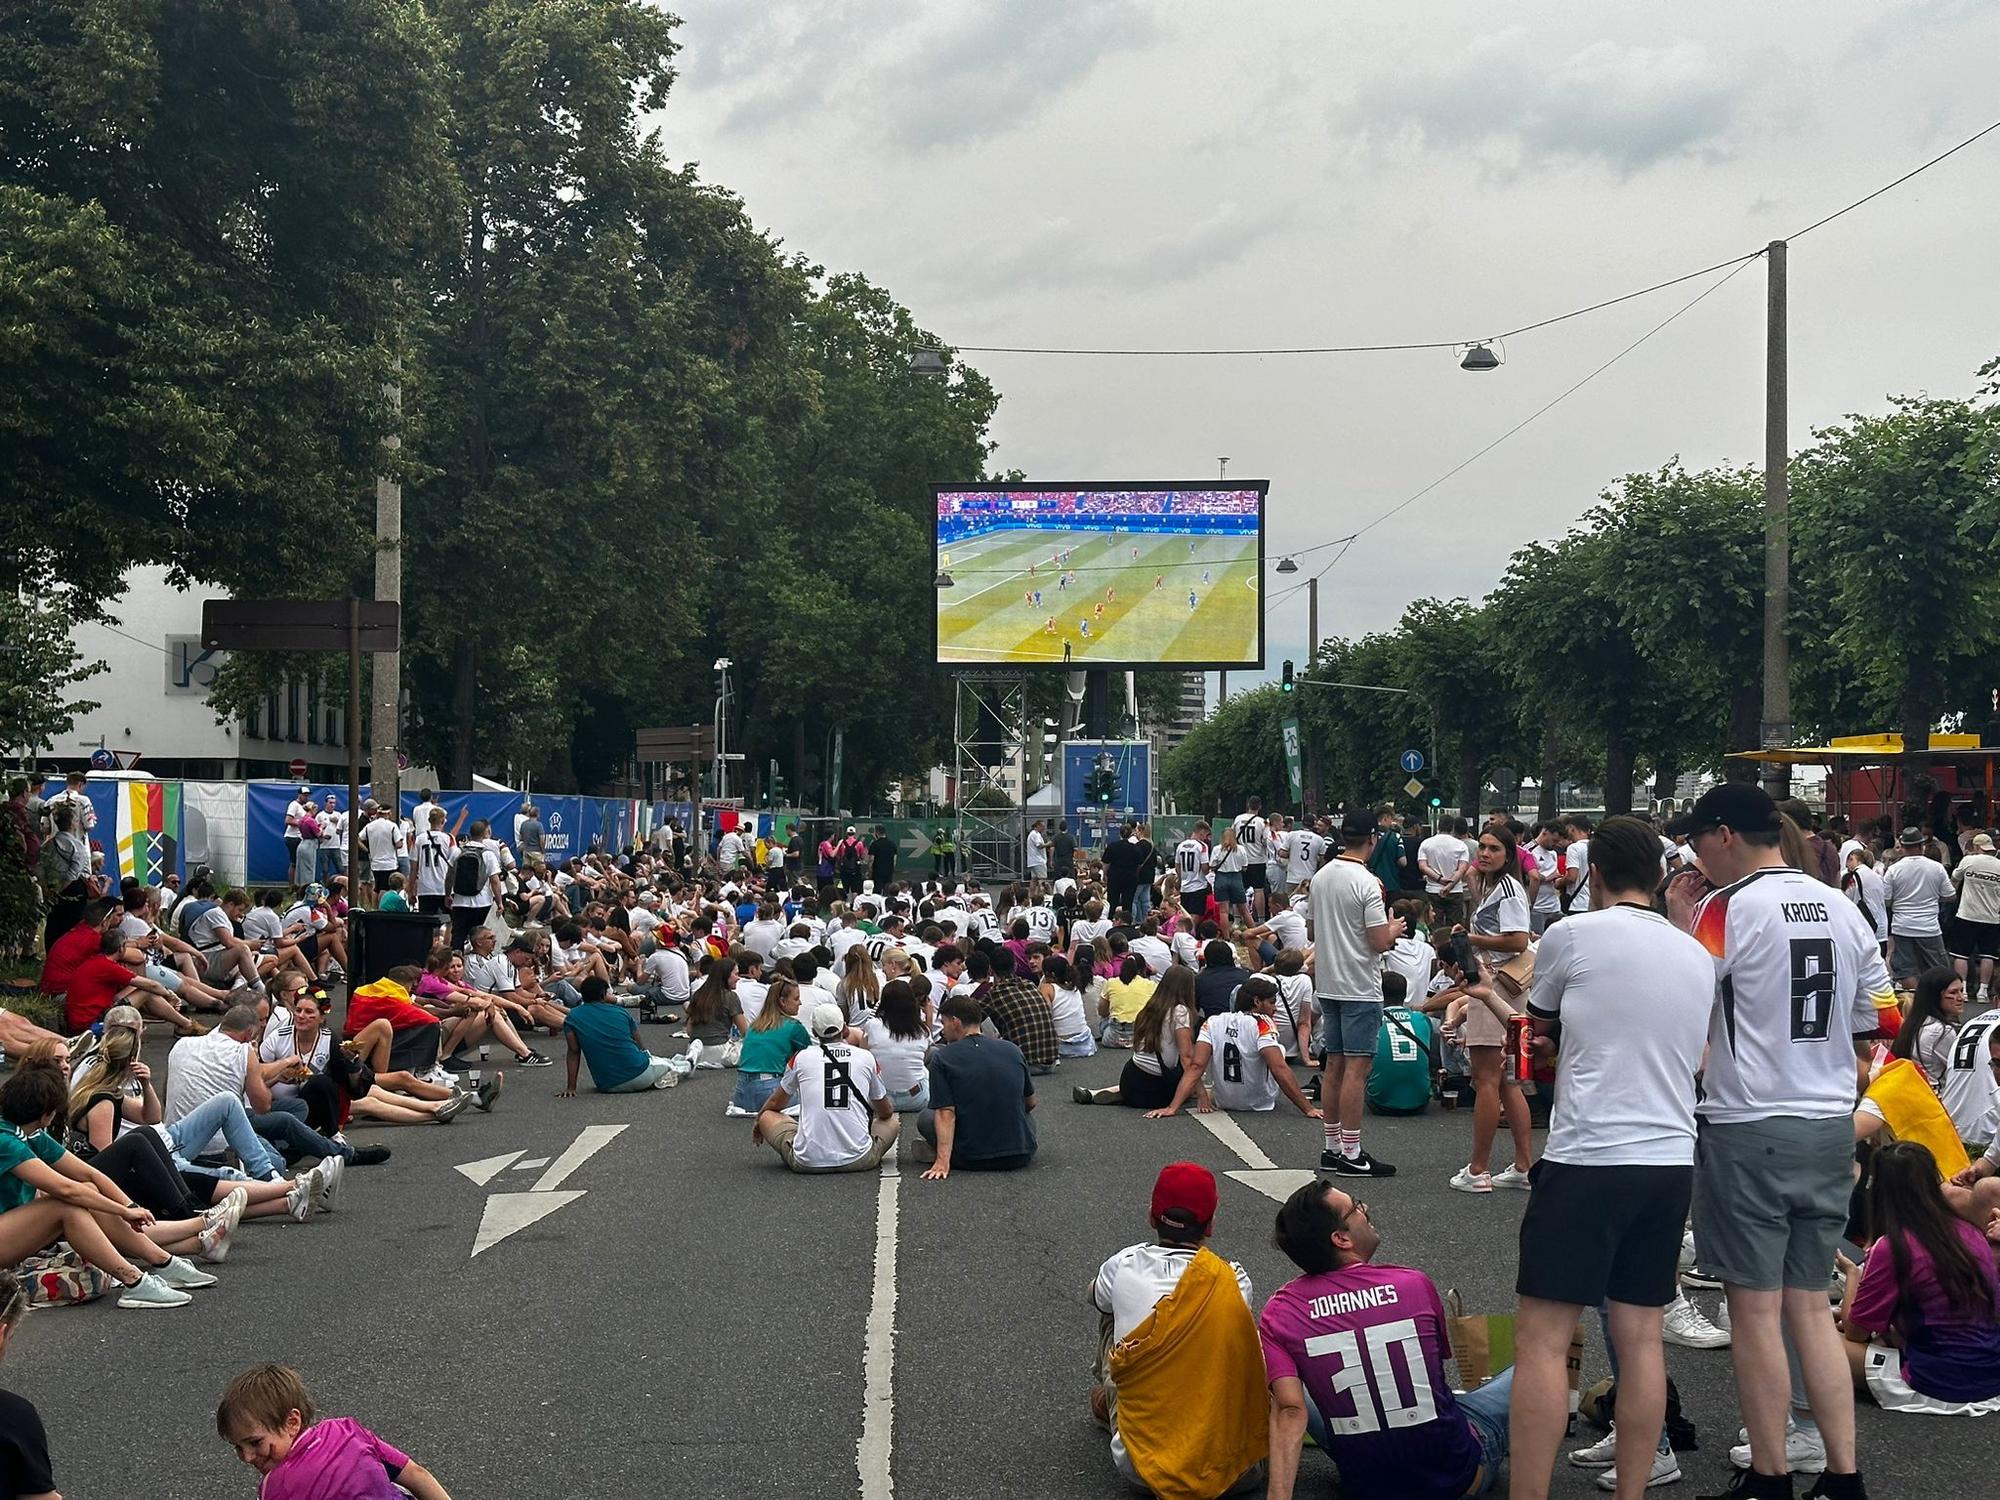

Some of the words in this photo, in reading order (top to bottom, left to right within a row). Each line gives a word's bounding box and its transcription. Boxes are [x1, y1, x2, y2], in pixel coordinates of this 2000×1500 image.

[1240, 826, 1256, 843] 10
[1180, 851, 1195, 872] 10
[1300, 841, 1311, 861] 3
[979, 913, 999, 929] 13
[1030, 911, 1049, 927] 13
[1781, 902, 1829, 922] KROOS
[1789, 938, 1837, 1043] 8
[1953, 1024, 1991, 1071] 8
[1223, 1042, 1242, 1083] 8
[824, 1062, 851, 1110] 8
[1308, 1284, 1399, 1320] JOHANNES
[1304, 1318, 1439, 1436] 30
